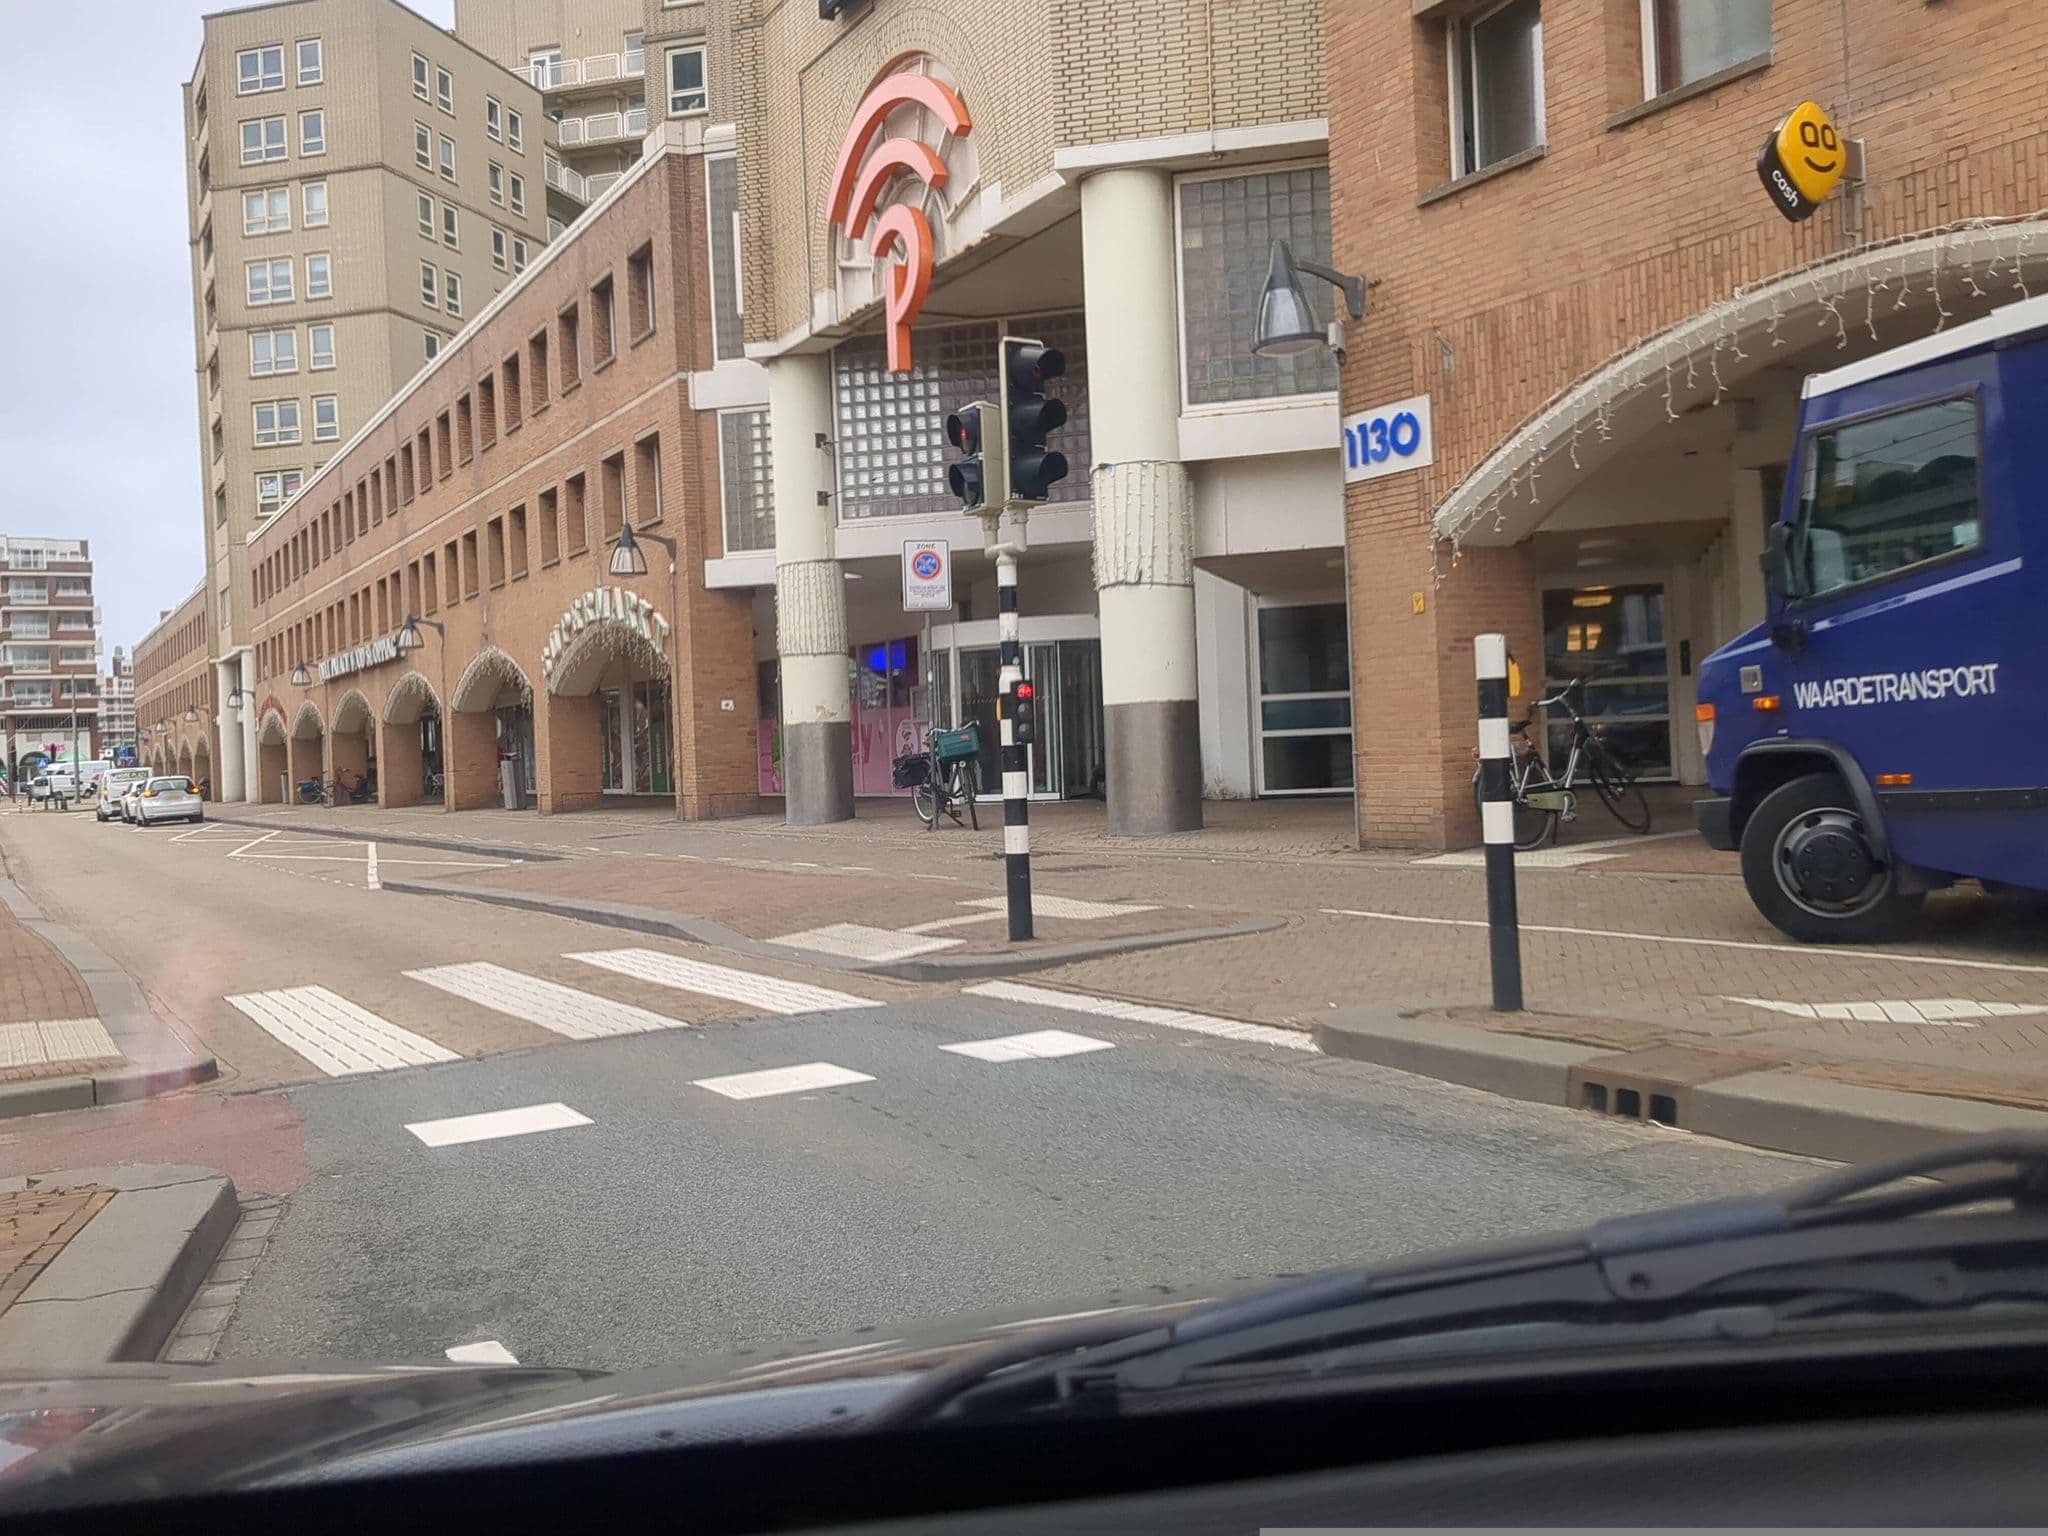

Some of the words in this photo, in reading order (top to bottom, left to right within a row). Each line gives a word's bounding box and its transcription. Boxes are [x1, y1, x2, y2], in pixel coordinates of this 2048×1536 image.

[1772, 169, 1799, 208] cash
[540, 585, 670, 679] SUPERMARKT
[1793, 663, 1999, 710] WAARDETRANSPORT
